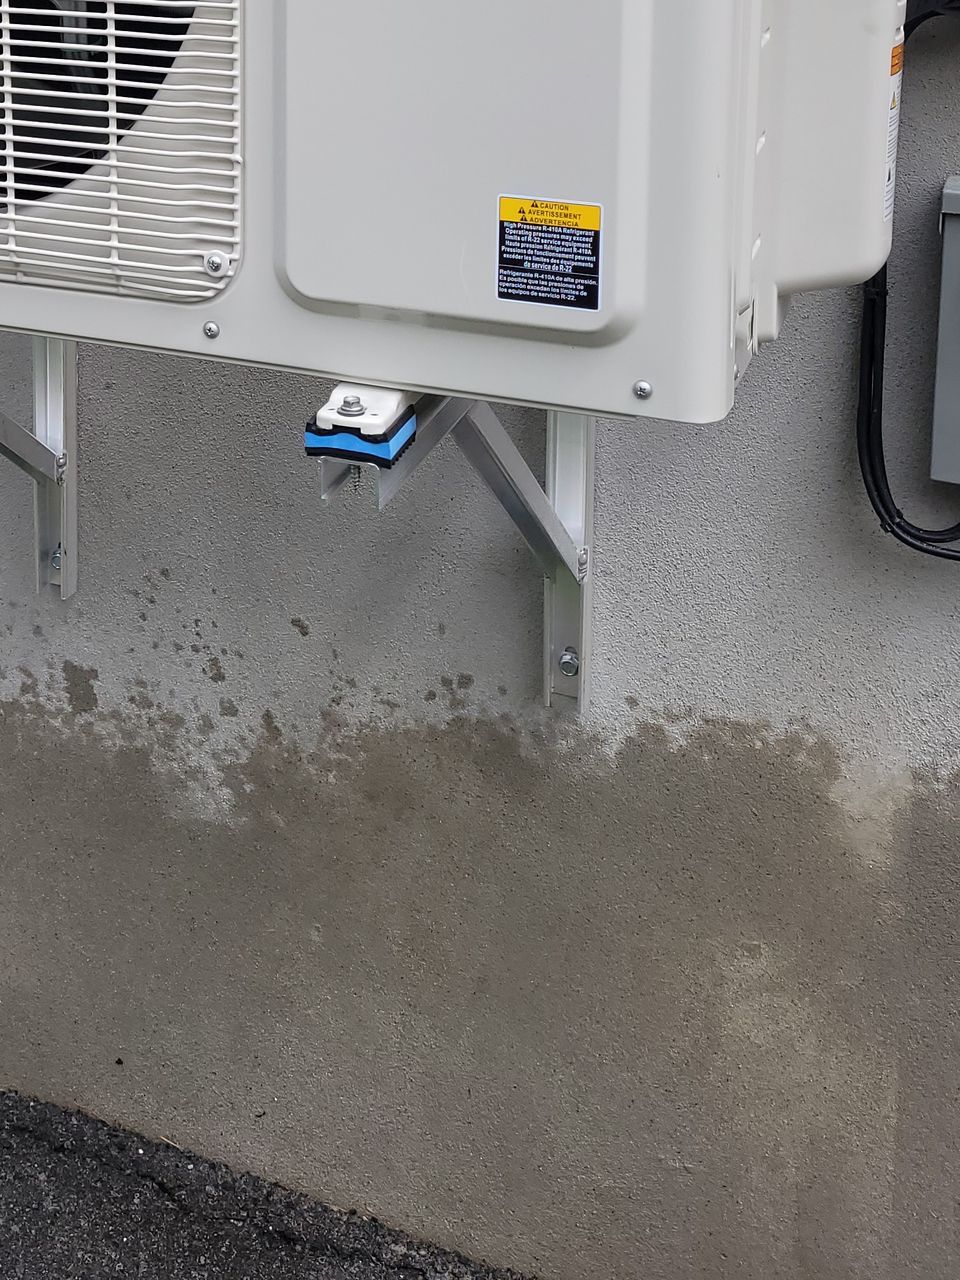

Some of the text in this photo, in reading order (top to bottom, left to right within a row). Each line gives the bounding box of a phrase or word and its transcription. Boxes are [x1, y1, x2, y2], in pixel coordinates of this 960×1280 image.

[540, 203, 569, 211] CAUTION
[528, 209, 581, 220] AVERTISSEMENT
[530, 218, 578, 227] ADVERTENCIA
[505, 228, 532, 237] Operating
[533, 231, 559, 239] pressures
[518, 223, 541, 231] Pressure
[563, 228, 594, 236] Refrigerant
[501, 246, 526, 254] Pressions
[521, 242, 542, 250] pression
[532, 262, 551, 270] service
[500, 269, 533, 277] Refrigerante
[549, 281, 575, 289] presiones
